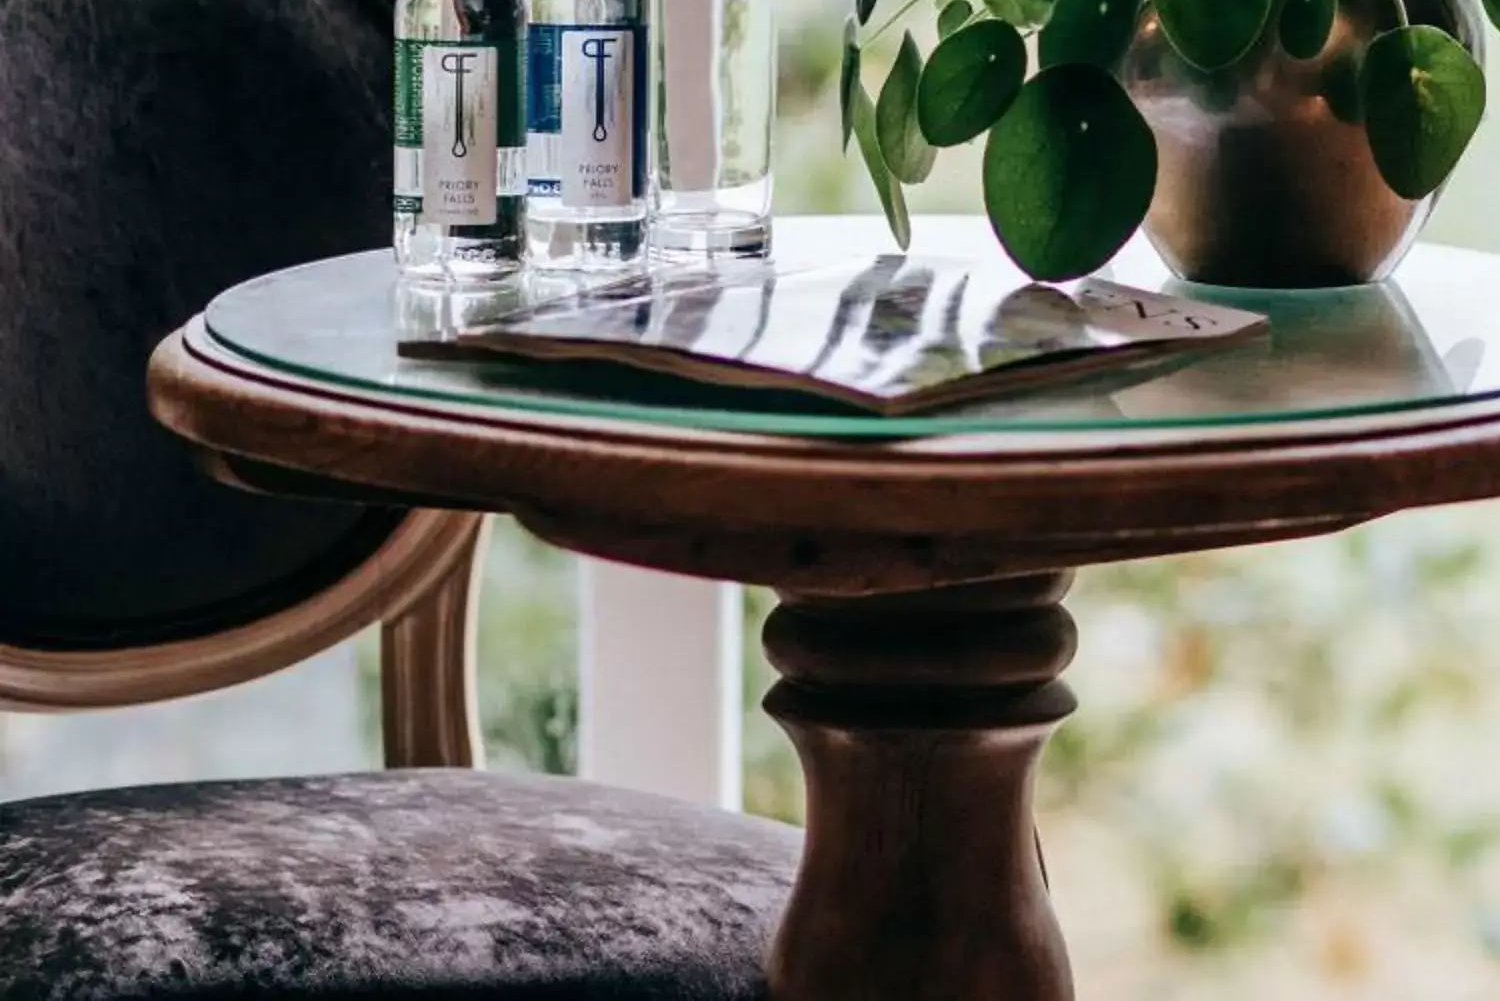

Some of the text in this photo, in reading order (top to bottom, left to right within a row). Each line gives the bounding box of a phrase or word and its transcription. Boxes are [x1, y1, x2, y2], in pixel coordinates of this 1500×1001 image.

[578, 164, 619, 175] PRIORY
[438, 180, 480, 191] PRIORY
[583, 178, 614, 189] FALLS
[443, 193, 475, 204] FALLS
